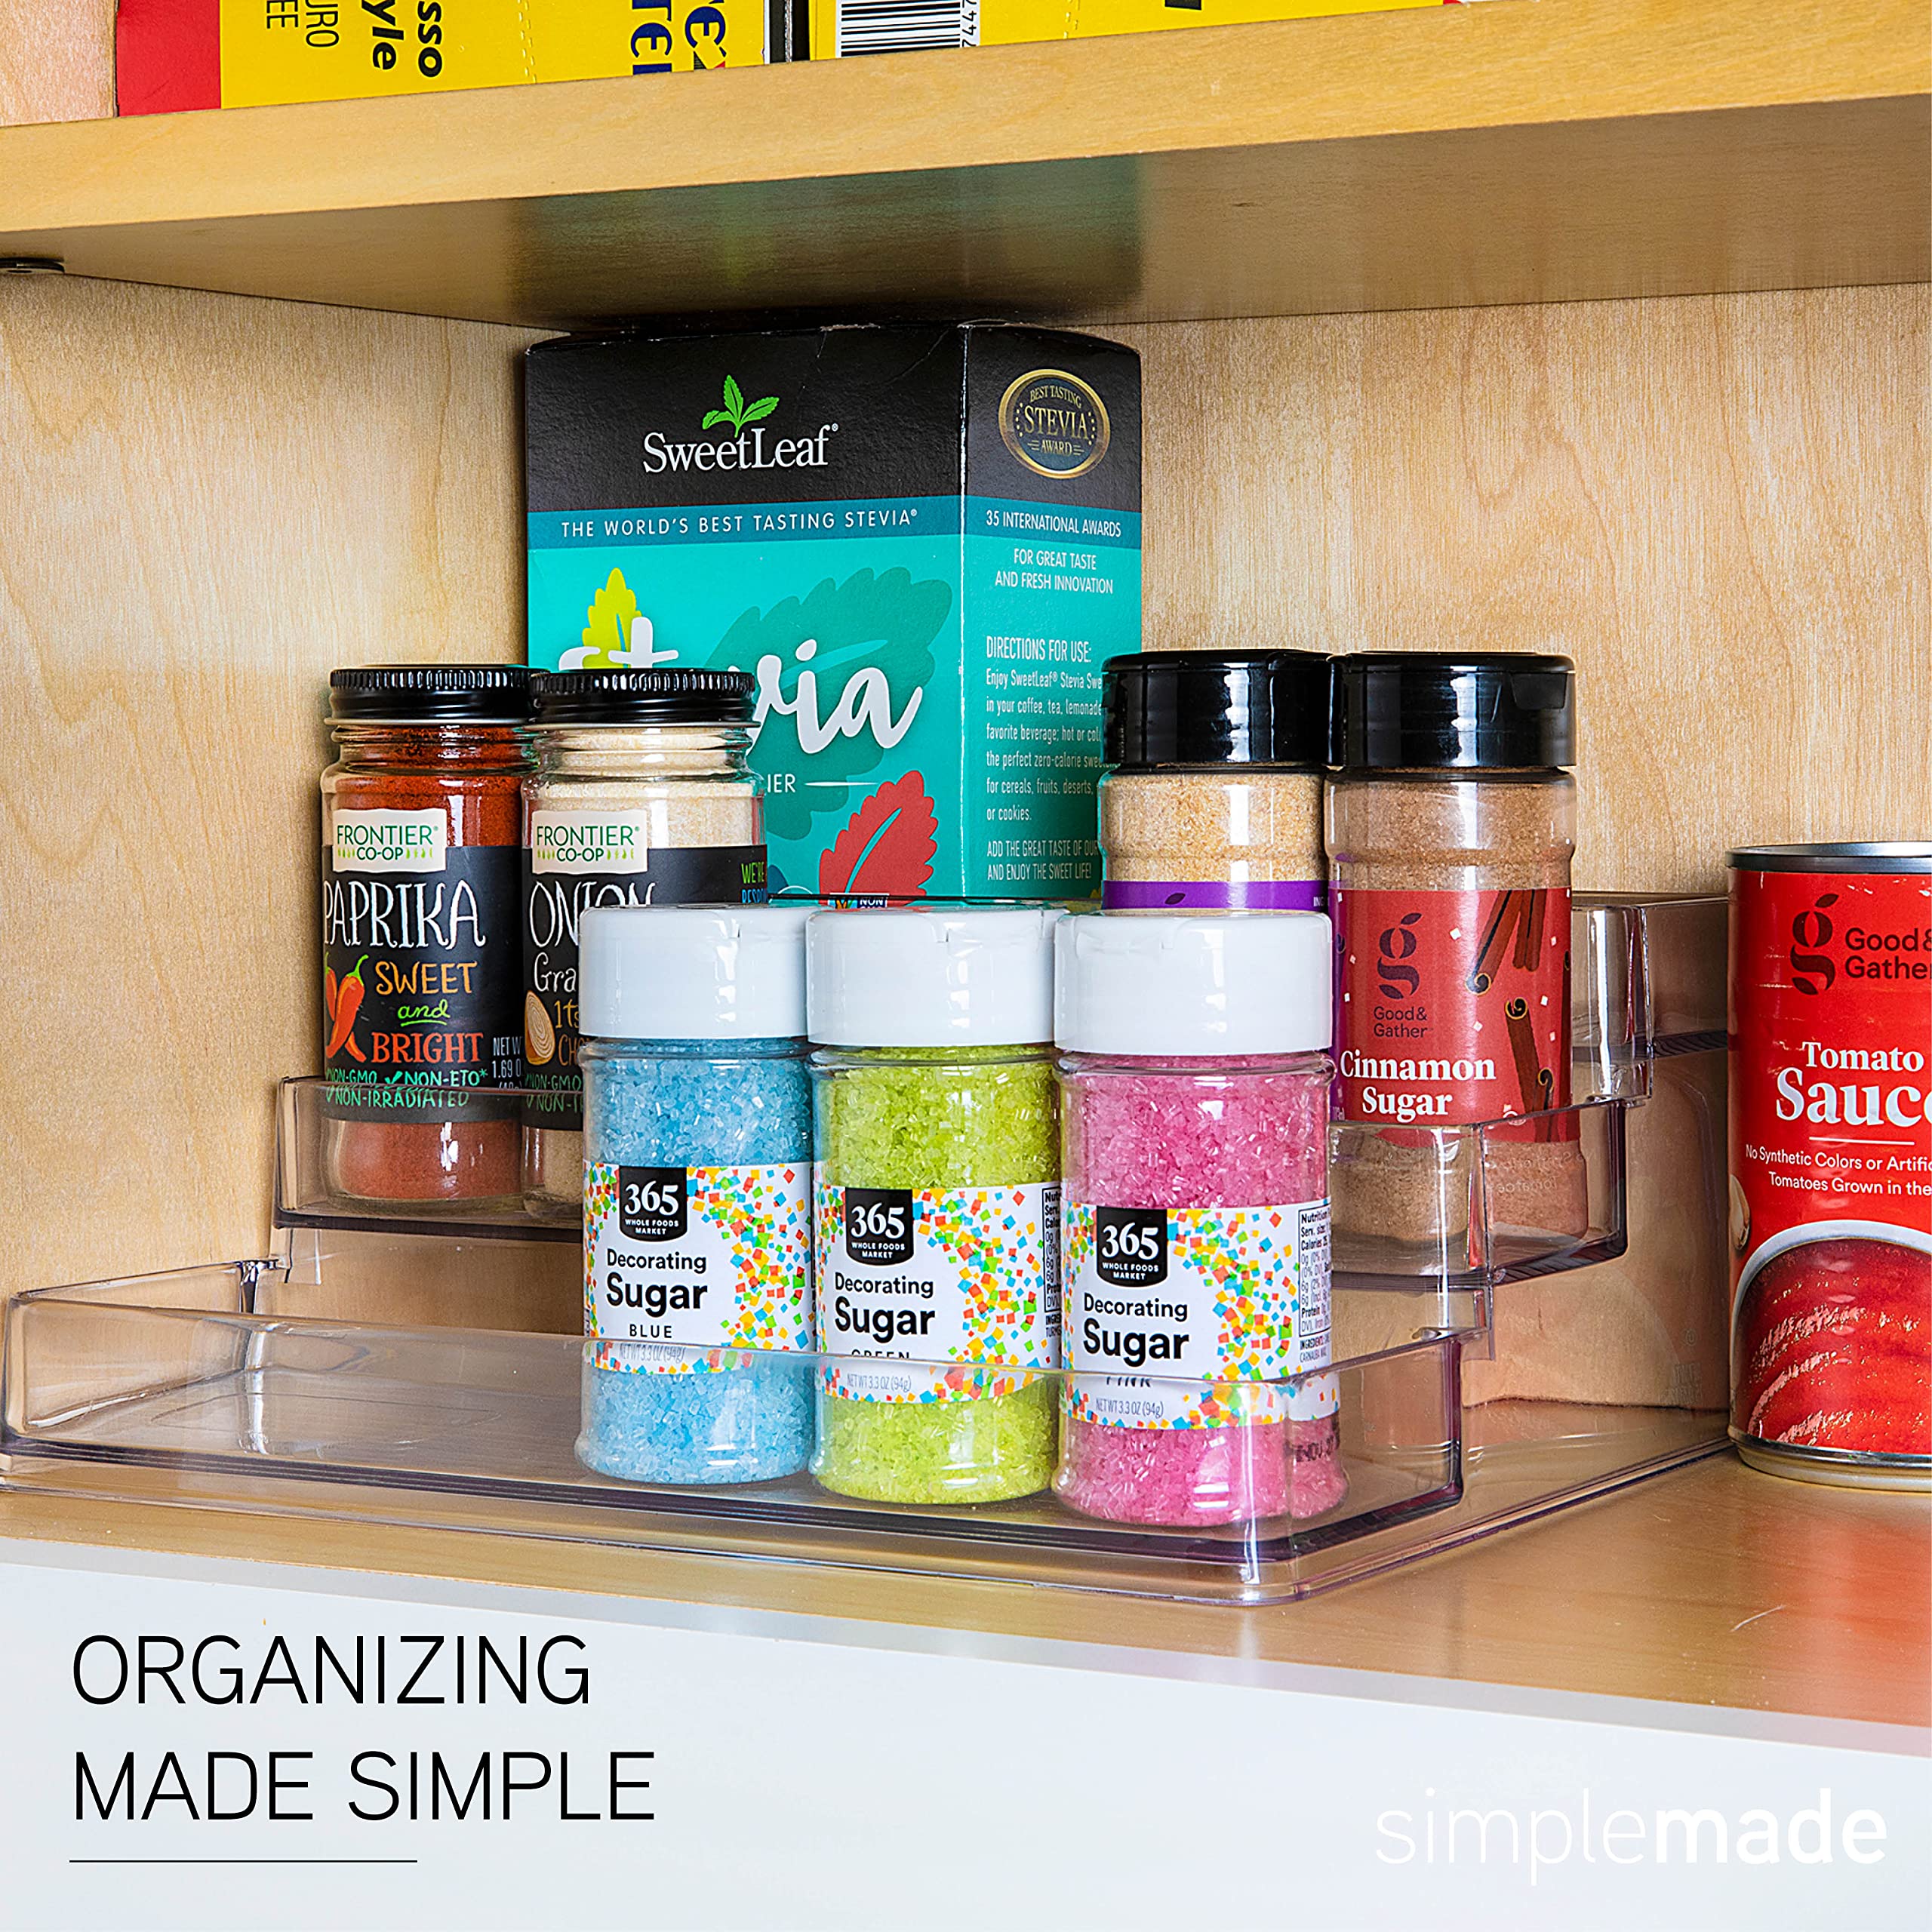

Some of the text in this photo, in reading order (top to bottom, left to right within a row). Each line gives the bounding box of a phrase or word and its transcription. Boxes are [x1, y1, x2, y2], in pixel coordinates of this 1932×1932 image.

[1030, 386, 1081, 408] BEST TASTING
[1024, 405, 1089, 440] STEVIA
[1041, 439, 1073, 457] AWARD
[561, 521, 595, 538] THE
[604, 518, 688, 537] WORLD'S
[698, 515, 743, 534] BEST
[753, 512, 835, 531] TASTING
[986, 509, 1121, 538] 35 INTERNATIONAL AWARDS
[1014, 548, 1097, 571] FOR GREAT TASTE
[995, 571, 1113, 594] AND FRESH INNOVATION
[986, 635, 1092, 663] DIRECTIONS FOR USE:
[986, 667, 1009, 690] Enjoy
[1060, 671, 1084, 689] Stevia
[986, 696, 995, 712] in
[996, 699, 1015, 717] your
[986, 722, 1018, 740] favorite
[1061, 725, 1075, 741] hot
[1076, 730, 1085, 742] or
[986, 750, 1000, 767] the
[1002, 751, 1032, 771] perfect
[1034, 752, 1081, 768] zero-calorie
[986, 777, 999, 794] for
[986, 804, 1032, 821] or cookies.
[356, 847, 404, 860] CO-OP
[556, 848, 605, 862] CO-OP
[986, 839, 1099, 857] ADD THE GREAT TASTE OF OUR
[987, 863, 1091, 881] AND ENJOY THE SWEET LIFE!
[324, 879, 487, 950] PAPRIKA
[375, 960, 478, 995] SWEET
[534, 952, 577, 993] Gra
[1845, 955, 1931, 980] Gathe
[398, 998, 451, 1019] and
[371, 1031, 485, 1064] BRIGHT
[493, 1037, 510, 1057] NET
[558, 1034, 586, 1066] CH
[1801, 1041, 1924, 1072] Tomato
[492, 1059, 513, 1078] 1.69
[1340, 1048, 1497, 1081] Cinnamon
[1361, 1085, 1454, 1124] Sugar
[1775, 1067, 1932, 1128] Sauc
[1746, 1143, 1758, 1160] No
[1759, 1146, 1812, 1166] Synthetic
[1814, 1152, 1863, 1170] Colors
[1866, 1158, 1883, 1171] or
[1768, 1171, 1931, 1196] Tomatoes Grown in the
[624, 1180, 679, 1217] 365
[625, 1218, 679, 1228] WHOLE FOODS
[635, 1227, 666, 1235] MARKET
[851, 1202, 905, 1239] 365
[851, 1241, 906, 1251] WHOLE FOODS
[1101, 1222, 1159, 1261] 365
[606, 1248, 707, 1275] Decorating
[861, 1250, 894, 1259] MARKET
[1102, 1262, 1159, 1272] WHOLE FOODS
[1112, 1271, 1146, 1281] MARKET
[606, 1272, 708, 1318] Sugar
[834, 1272, 934, 1299] Decorating
[1083, 1291, 1189, 1322] Decorating
[629, 1323, 672, 1339] BLUE
[834, 1296, 936, 1344] Sugar
[1083, 1318, 1190, 1367] Sugar
[891, 1374, 912, 1393] (94g)
[1096, 1397, 1106, 1412] NET
[1131, 1401, 1142, 1416] OZ
[1142, 1400, 1164, 1420] (94g)
